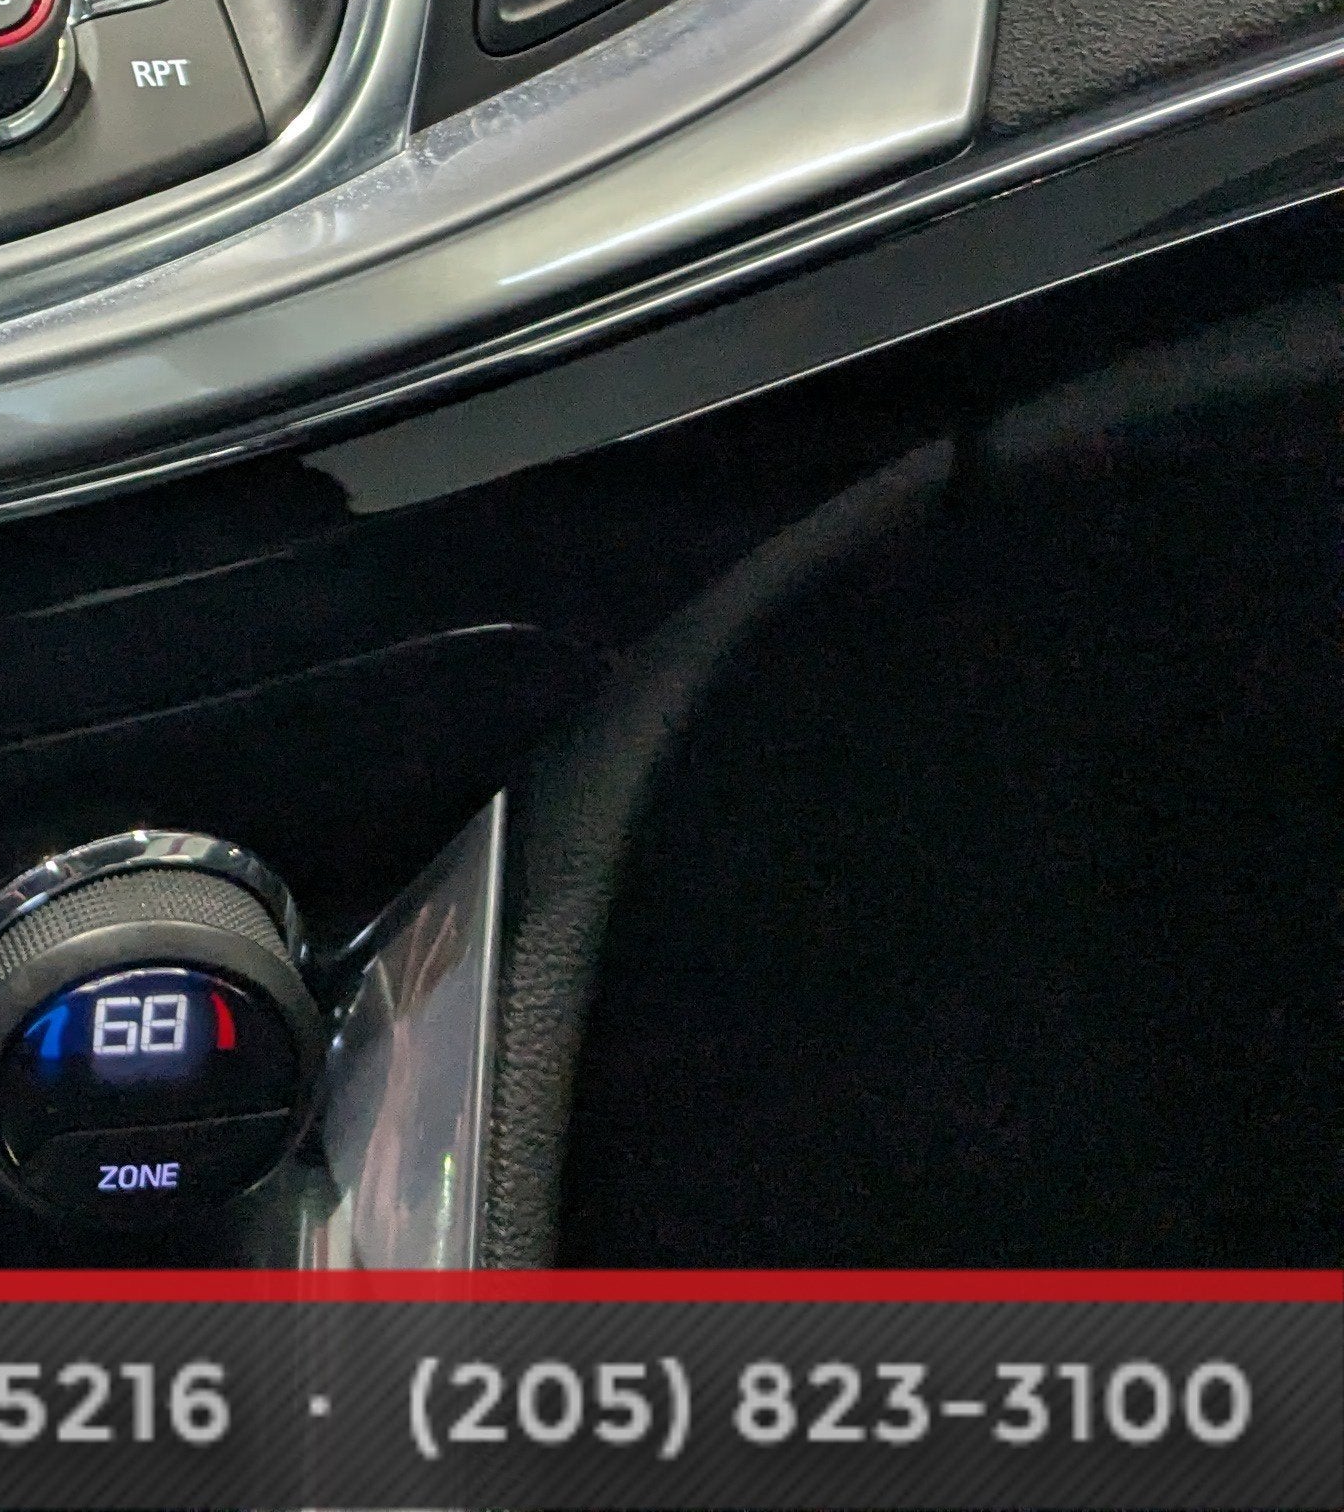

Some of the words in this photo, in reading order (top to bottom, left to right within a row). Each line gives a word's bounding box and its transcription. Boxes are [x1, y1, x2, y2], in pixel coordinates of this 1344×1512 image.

[131, 58, 189, 88] RPT
[91, 992, 188, 1056] 68
[97, 1162, 180, 1190] ZONE
